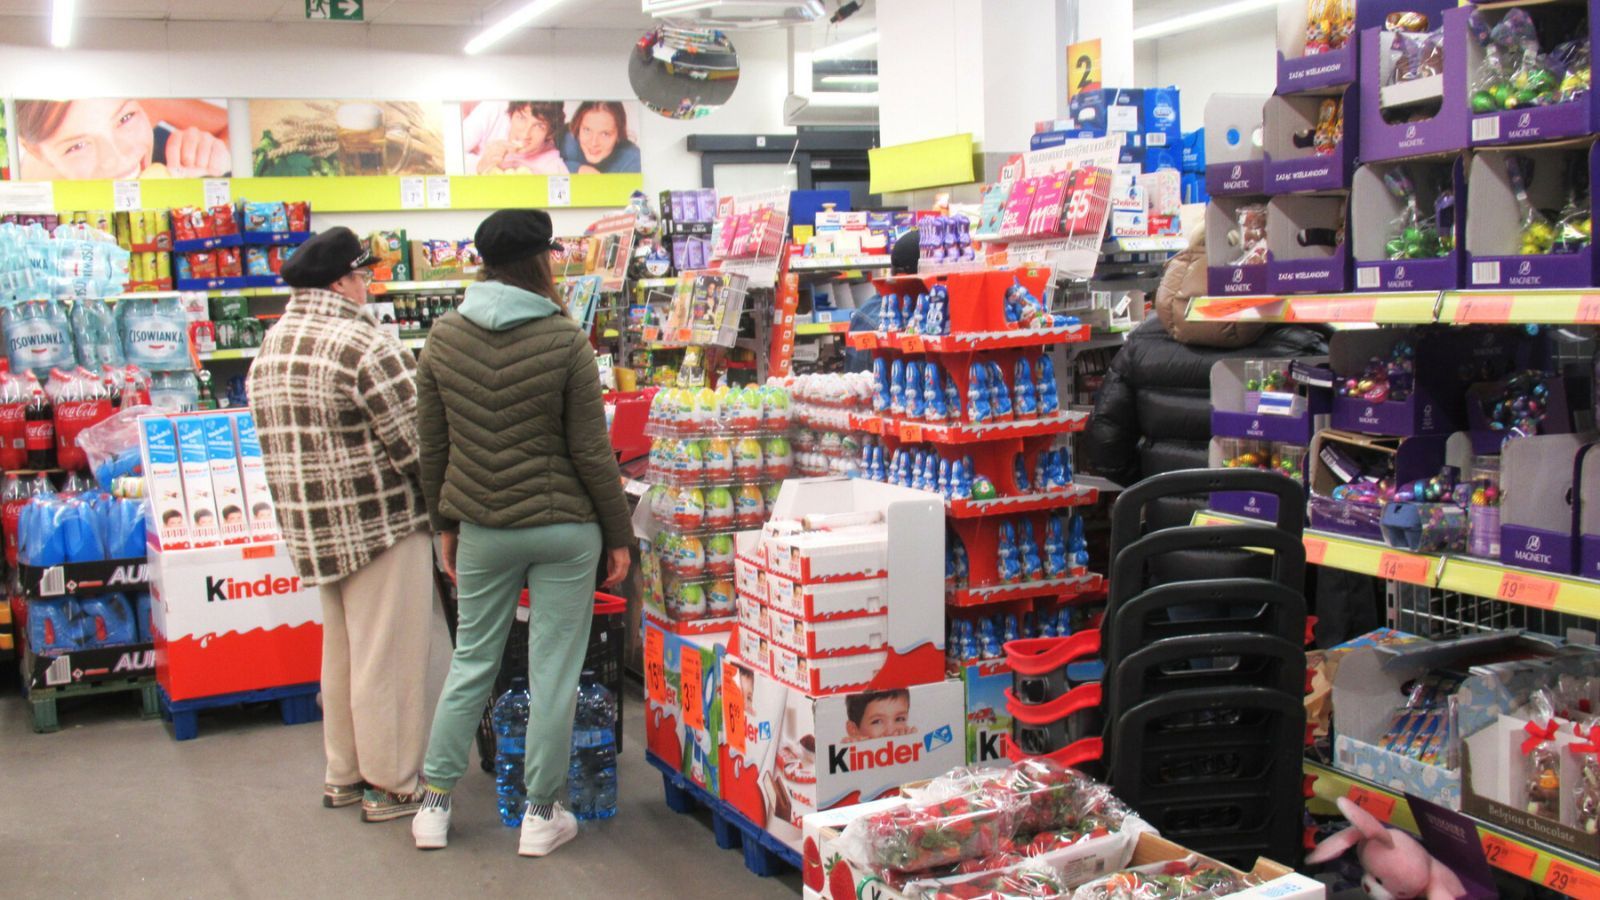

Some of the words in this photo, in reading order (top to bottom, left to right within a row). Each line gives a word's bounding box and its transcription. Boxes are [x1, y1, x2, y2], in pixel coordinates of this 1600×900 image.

[1076, 55, 1093, 89] 2
[1508, 127, 1540, 139] MAGNETIC
[1398, 137, 1425, 148] MAGNETIC
[1223, 179, 1250, 190] MAGNETIC
[1067, 189, 1090, 219] 55
[1223, 283, 1252, 292] MAGNETIC
[1387, 279, 1413, 289] MAGNETIC
[1509, 275, 1541, 286] MAGNETIC
[129, 329, 184, 344] CISOWIANKA
[1514, 550, 1552, 565] MAGNETIC
[1502, 580, 1518, 599] 19
[1488, 802, 1524, 826] Belgian
[1526, 817, 1576, 843] Chocolate
[1485, 842, 1501, 862] 12
[1549, 870, 1569, 891] 29
